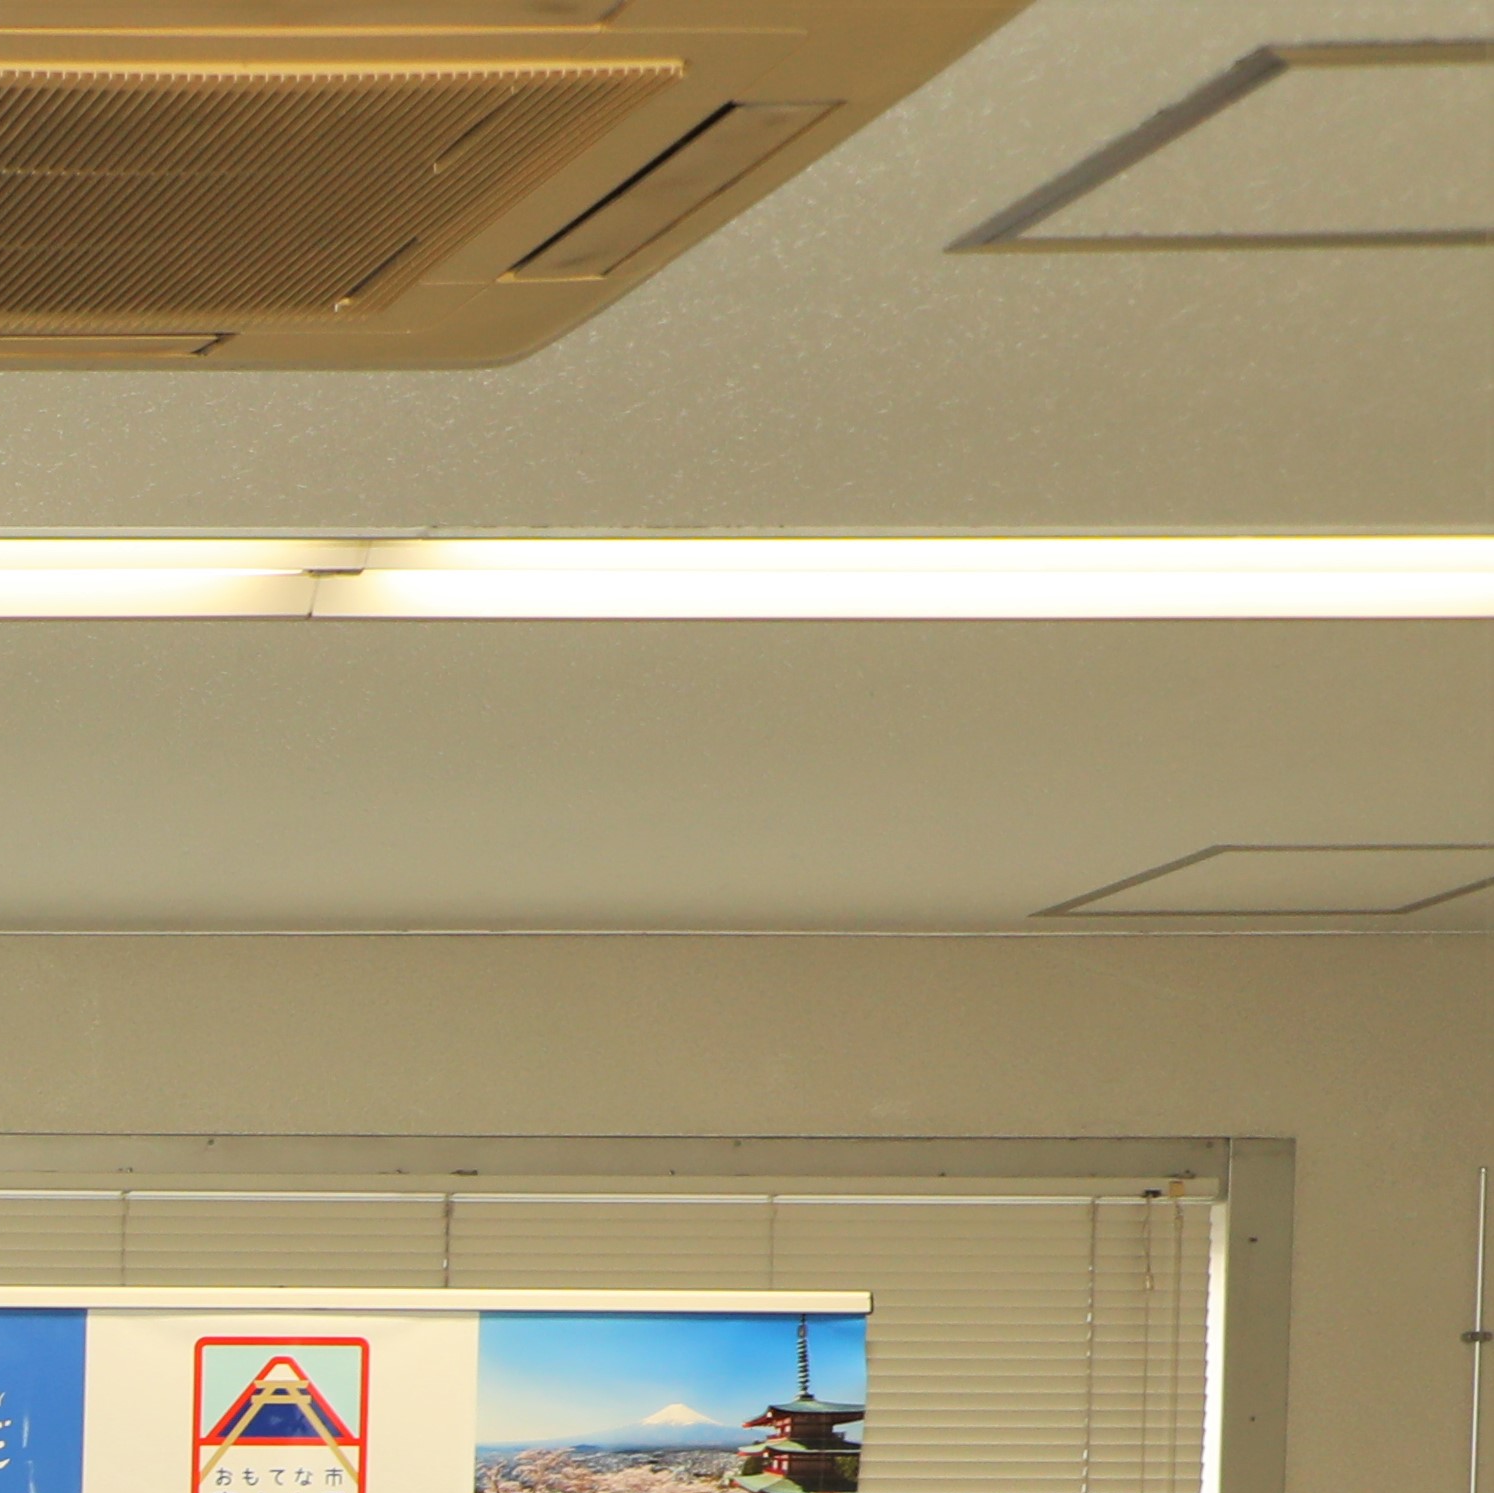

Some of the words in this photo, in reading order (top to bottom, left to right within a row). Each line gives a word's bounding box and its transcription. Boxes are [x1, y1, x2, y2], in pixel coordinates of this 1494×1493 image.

[215, 1467, 344, 1487] おもてな市
